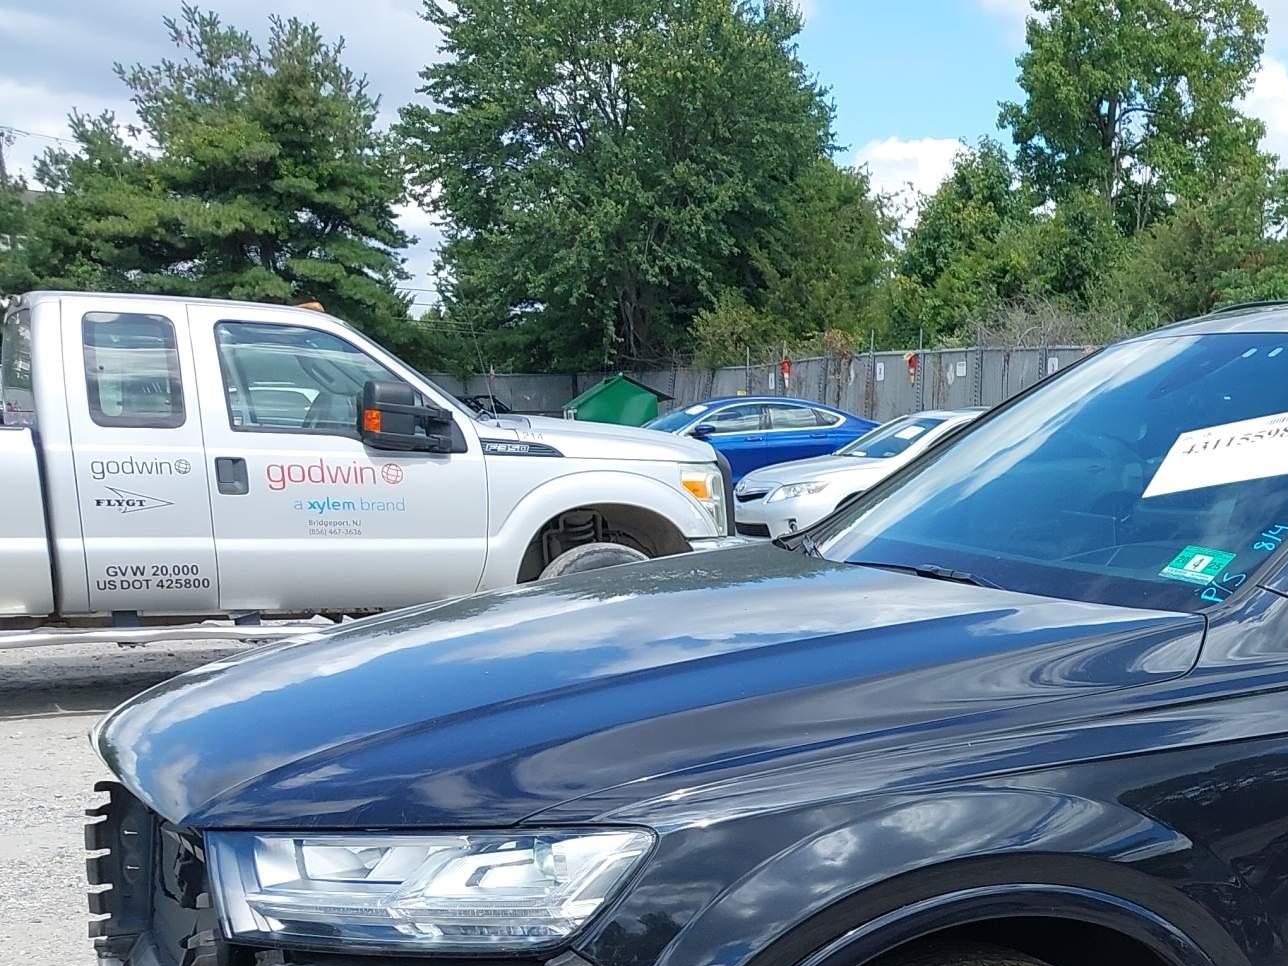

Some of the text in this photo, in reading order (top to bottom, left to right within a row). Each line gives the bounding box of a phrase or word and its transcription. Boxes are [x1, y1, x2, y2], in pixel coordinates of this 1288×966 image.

[90, 455, 173, 480] godwin
[266, 457, 377, 491] godwin
[94, 498, 147, 507] FLYGT
[294, 496, 406, 514] a xylem brand
[308, 519, 352, 527] Bridgeport,
[105, 564, 199, 578] GVW 20,000
[156, 577, 211, 590] 425800
